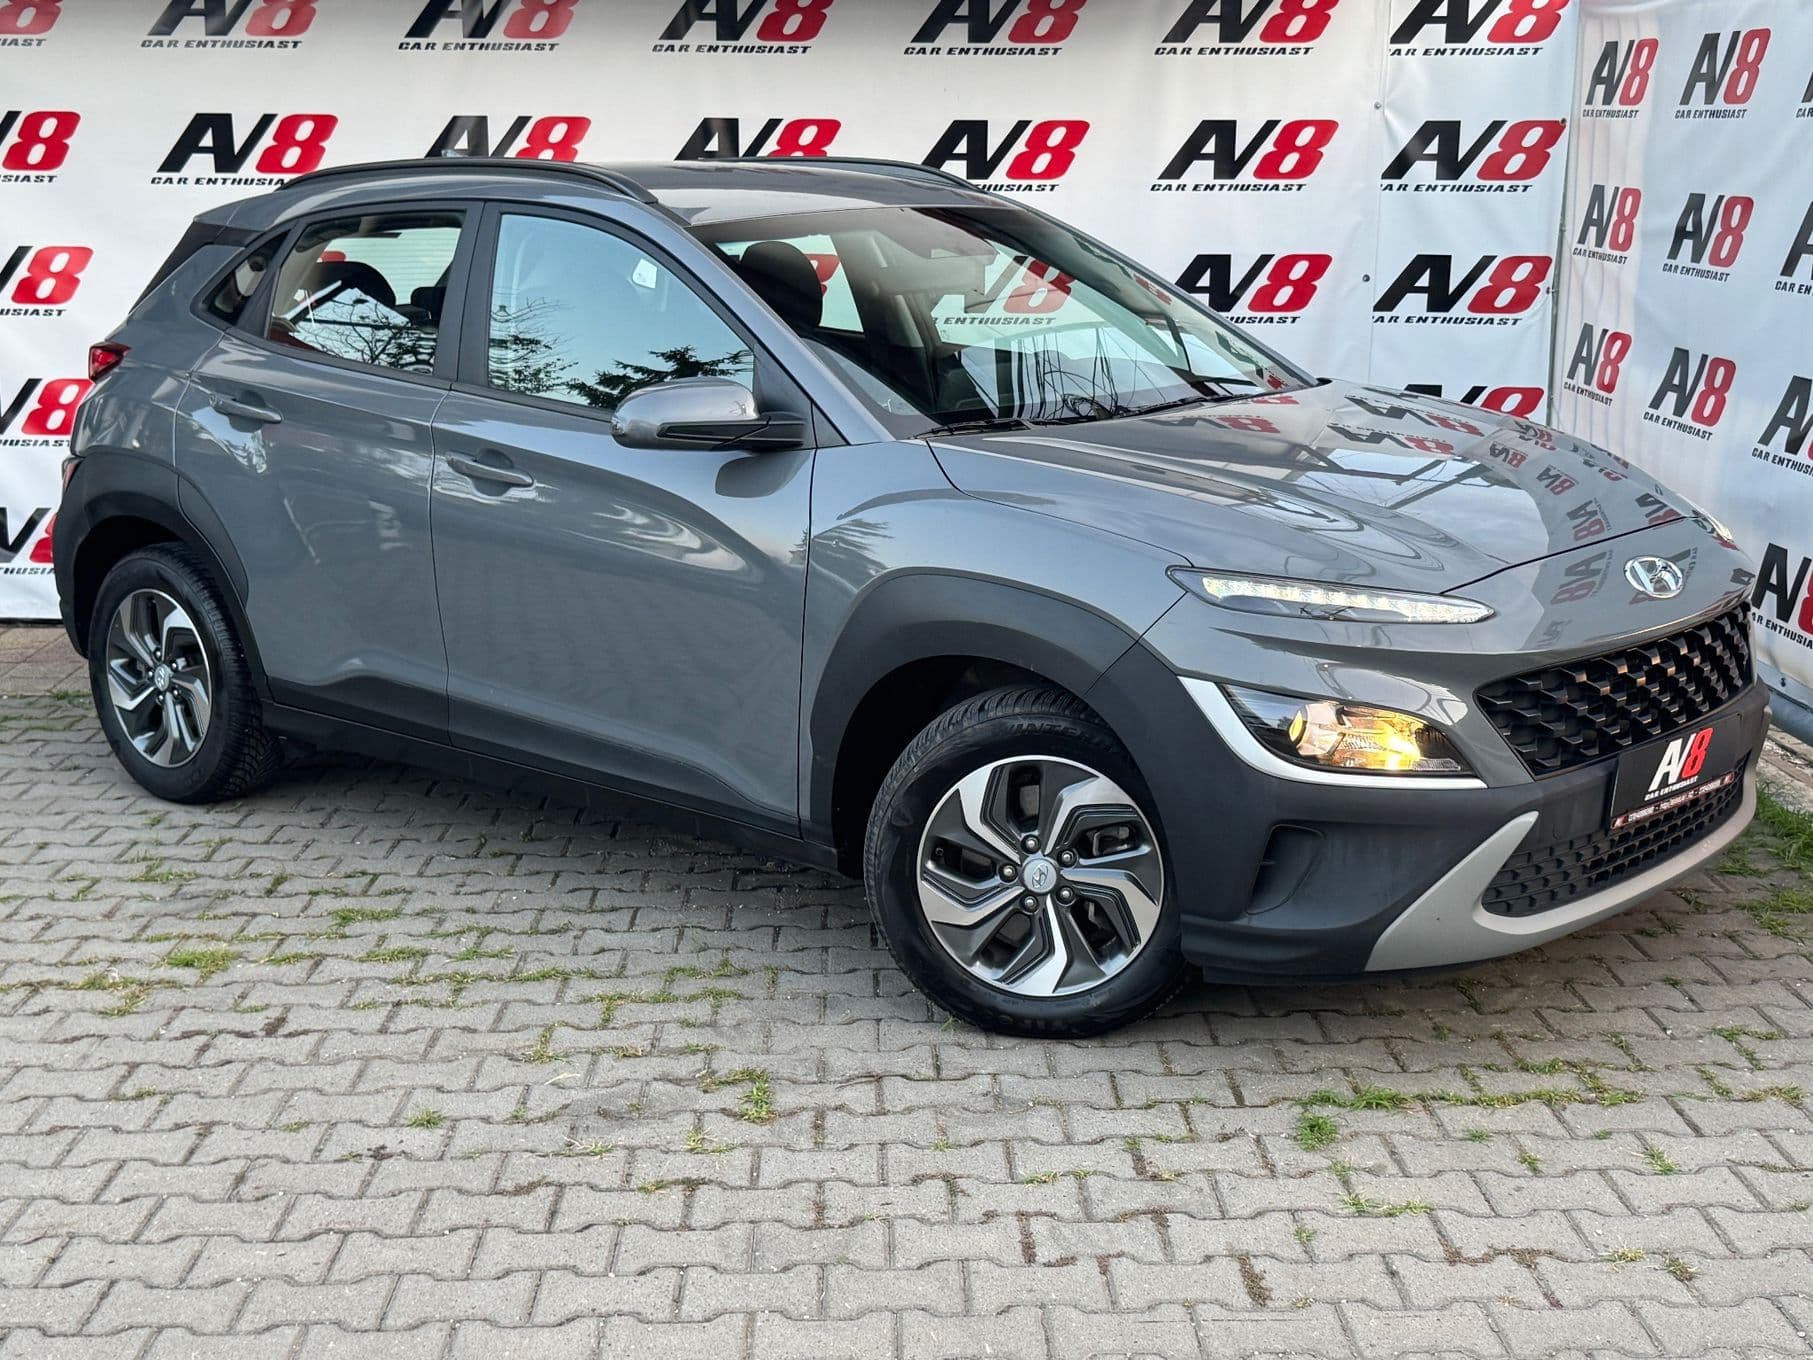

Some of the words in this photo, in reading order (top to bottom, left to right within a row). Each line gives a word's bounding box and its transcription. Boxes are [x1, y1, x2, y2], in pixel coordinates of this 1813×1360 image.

[910, 0, 1087, 43] AV8
[1161, 0, 1339, 43] AV8
[141, 39, 178, 48] CAR
[184, 40, 302, 49] ENTHUSIAST
[398, 42, 437, 50] CAR
[442, 43, 559, 51] ENTHUSIAST
[652, 44, 690, 53] CAR
[695, 45, 812, 54] ENTHUSIAST
[904, 47, 941, 55] CAR
[946, 47, 1062, 56] ENTHUSIAST
[1154, 47, 1192, 55] CAR
[1197, 47, 1314, 56] ENTHUSIAST
[1389, 48, 1417, 57] AR
[1422, 48, 1543, 56] ENTHUSIAST
[1585, 38, 1659, 106] AV8
[1678, 28, 1771, 106] AV8
[1582, 109, 1594, 118] CAR
[1595, 109, 1639, 119] ENTHUSIAST
[1674, 109, 1691, 119] CAR
[1693, 109, 1747, 119] ENTHUSIAST
[157, 112, 339, 174] AV8
[424, 115, 592, 162] AV8
[674, 117, 842, 161] AV8
[921, 119, 1090, 180] AV8
[1157, 119, 1340, 180] AV8
[1381, 119, 1567, 181] AV8
[151, 177, 188, 185] CAR
[194, 177, 286, 186] ENTHUSIA
[1150, 184, 1187, 192] CAR
[1192, 184, 1306, 192] ENTHUSIAST
[1380, 183, 1408, 192] AR
[1413, 184, 1532, 192] ENTHUSIAST
[1577, 184, 1642, 252] AV8
[1667, 192, 1754, 268] AV8
[1573, 247, 1587, 257] CAR
[1588, 250, 1628, 264] ENTHUSIAST
[1175, 254, 1333, 312] AV8
[1373, 254, 1553, 314] AV8
[1662, 263, 1679, 274] CAR
[1679, 266, 1730, 282] ENTHUSIAST
[1775, 281, 1796, 293] CAR
[944, 317, 1057, 325] ENTHUSIAST
[1373, 315, 1400, 324] AR
[1405, 316, 1522, 326] ENTHUSIAST
[1567, 322, 1633, 394] AV8
[1563, 381, 1576, 393] CAR
[1576, 386, 1613, 407] ENTHUSIAST
[1648, 346, 1736, 427] AV8
[1643, 411, 1660, 423] CAR
[1661, 417, 1713, 441] ENTHUSIAST
[1752, 447, 1770, 462] CAR
[1765, 618, 1813, 650] ENTHUSIA
[1648, 727, 1714, 792] AV8
[1644, 790, 1660, 801] CAR
